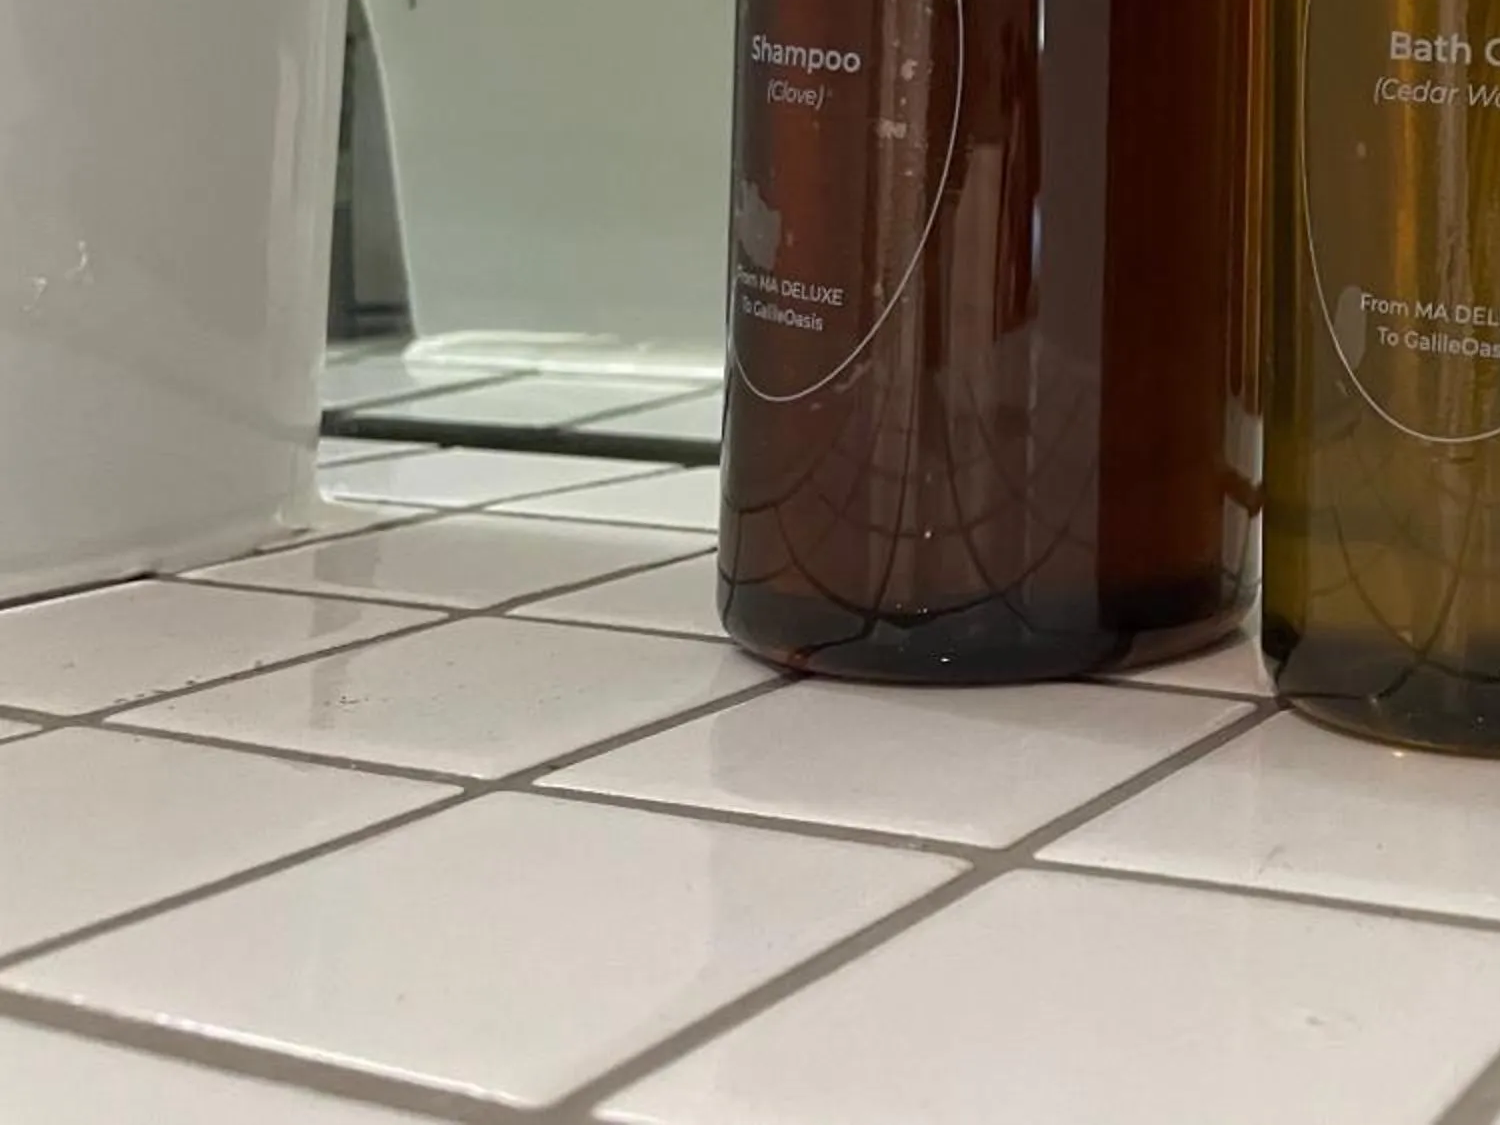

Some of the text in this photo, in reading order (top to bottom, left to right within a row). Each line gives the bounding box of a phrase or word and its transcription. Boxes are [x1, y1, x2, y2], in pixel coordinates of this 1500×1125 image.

[752, 34, 862, 74] Shampoo
[1389, 30, 1472, 65] Bath
[767, 79, 824, 111] (Clove)
[1374, 76, 1458, 105] (Cedar
[759, 275, 780, 294] MA
[781, 279, 845, 307] DELUXE
[1360, 292, 1410, 318] From
[1415, 299, 1449, 323] MA
[1377, 326, 1399, 346] To
